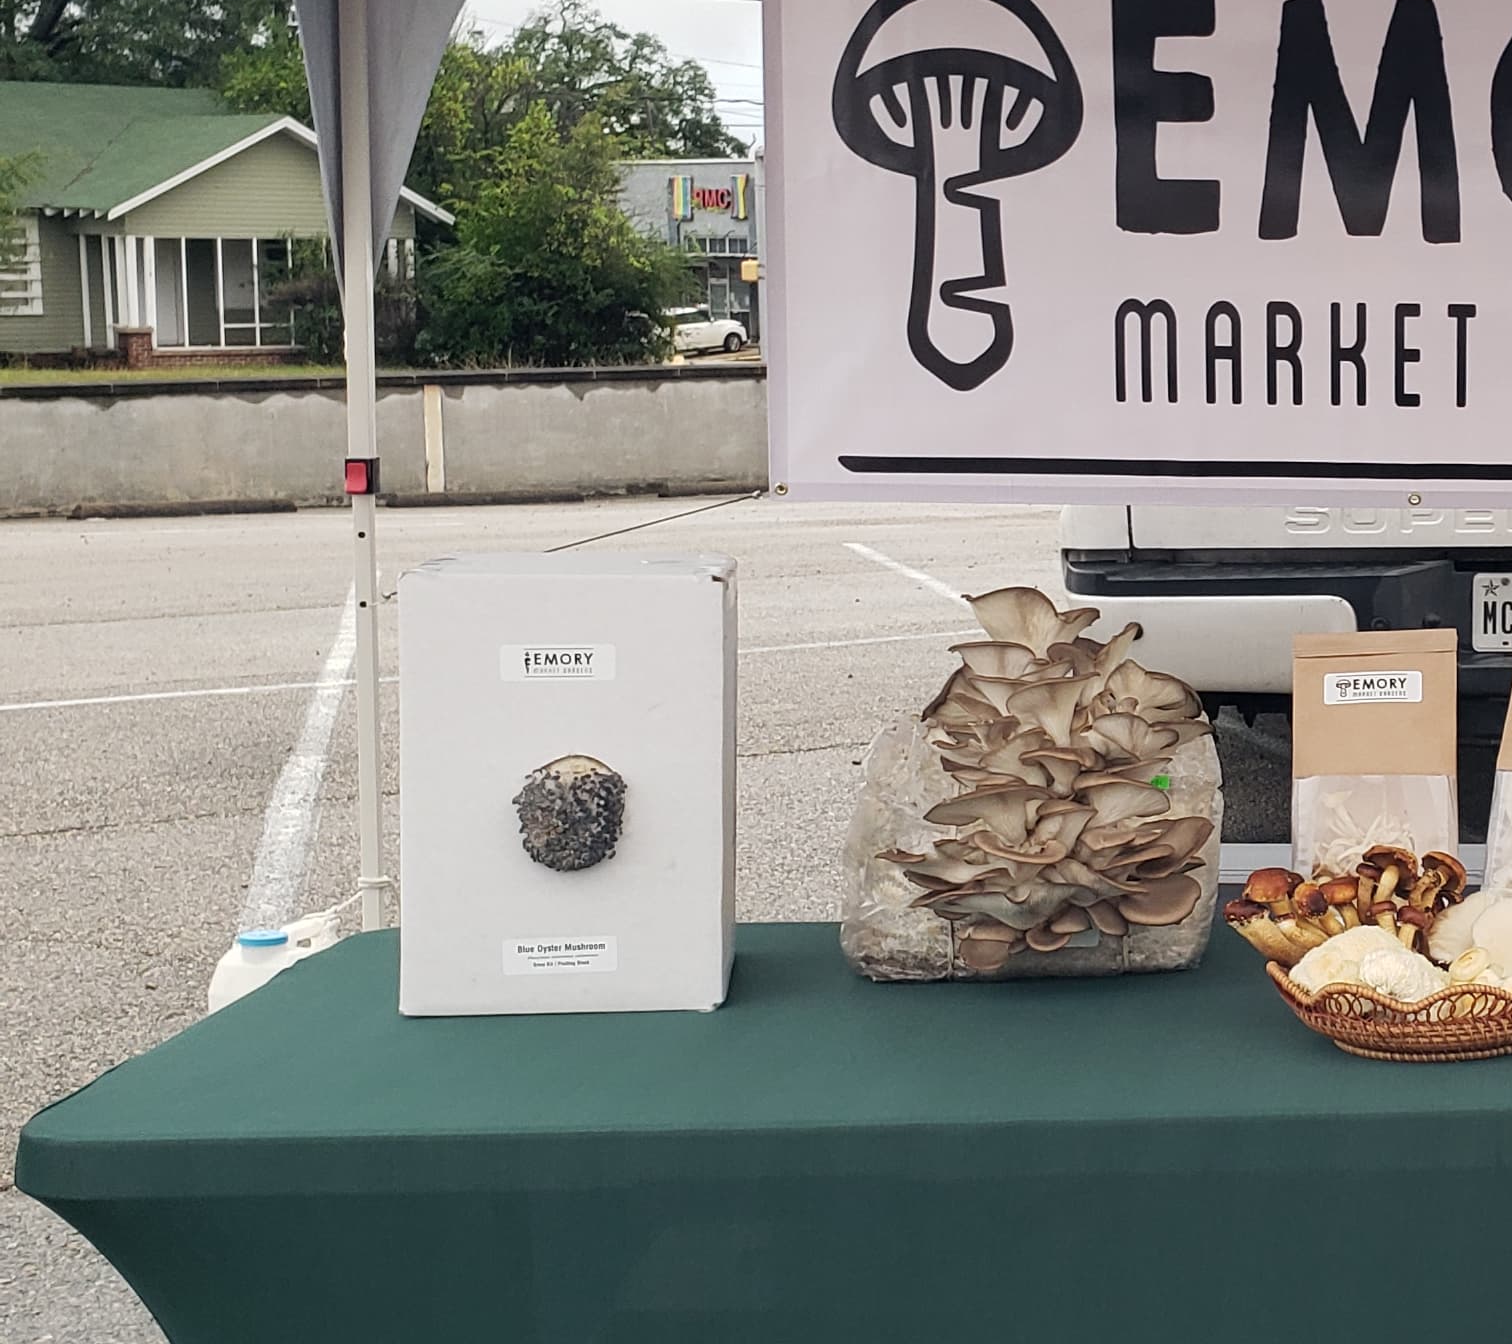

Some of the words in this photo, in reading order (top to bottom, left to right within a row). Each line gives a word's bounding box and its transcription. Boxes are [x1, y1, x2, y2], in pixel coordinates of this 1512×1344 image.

[1114, 298, 1477, 408] MARKET
[533, 653, 594, 665] EMORY
[1353, 677, 1407, 690] EMORY
[517, 945, 534, 953] Blue
[537, 944, 562, 954] Oyster
[564, 943, 606, 952] Mushroom
